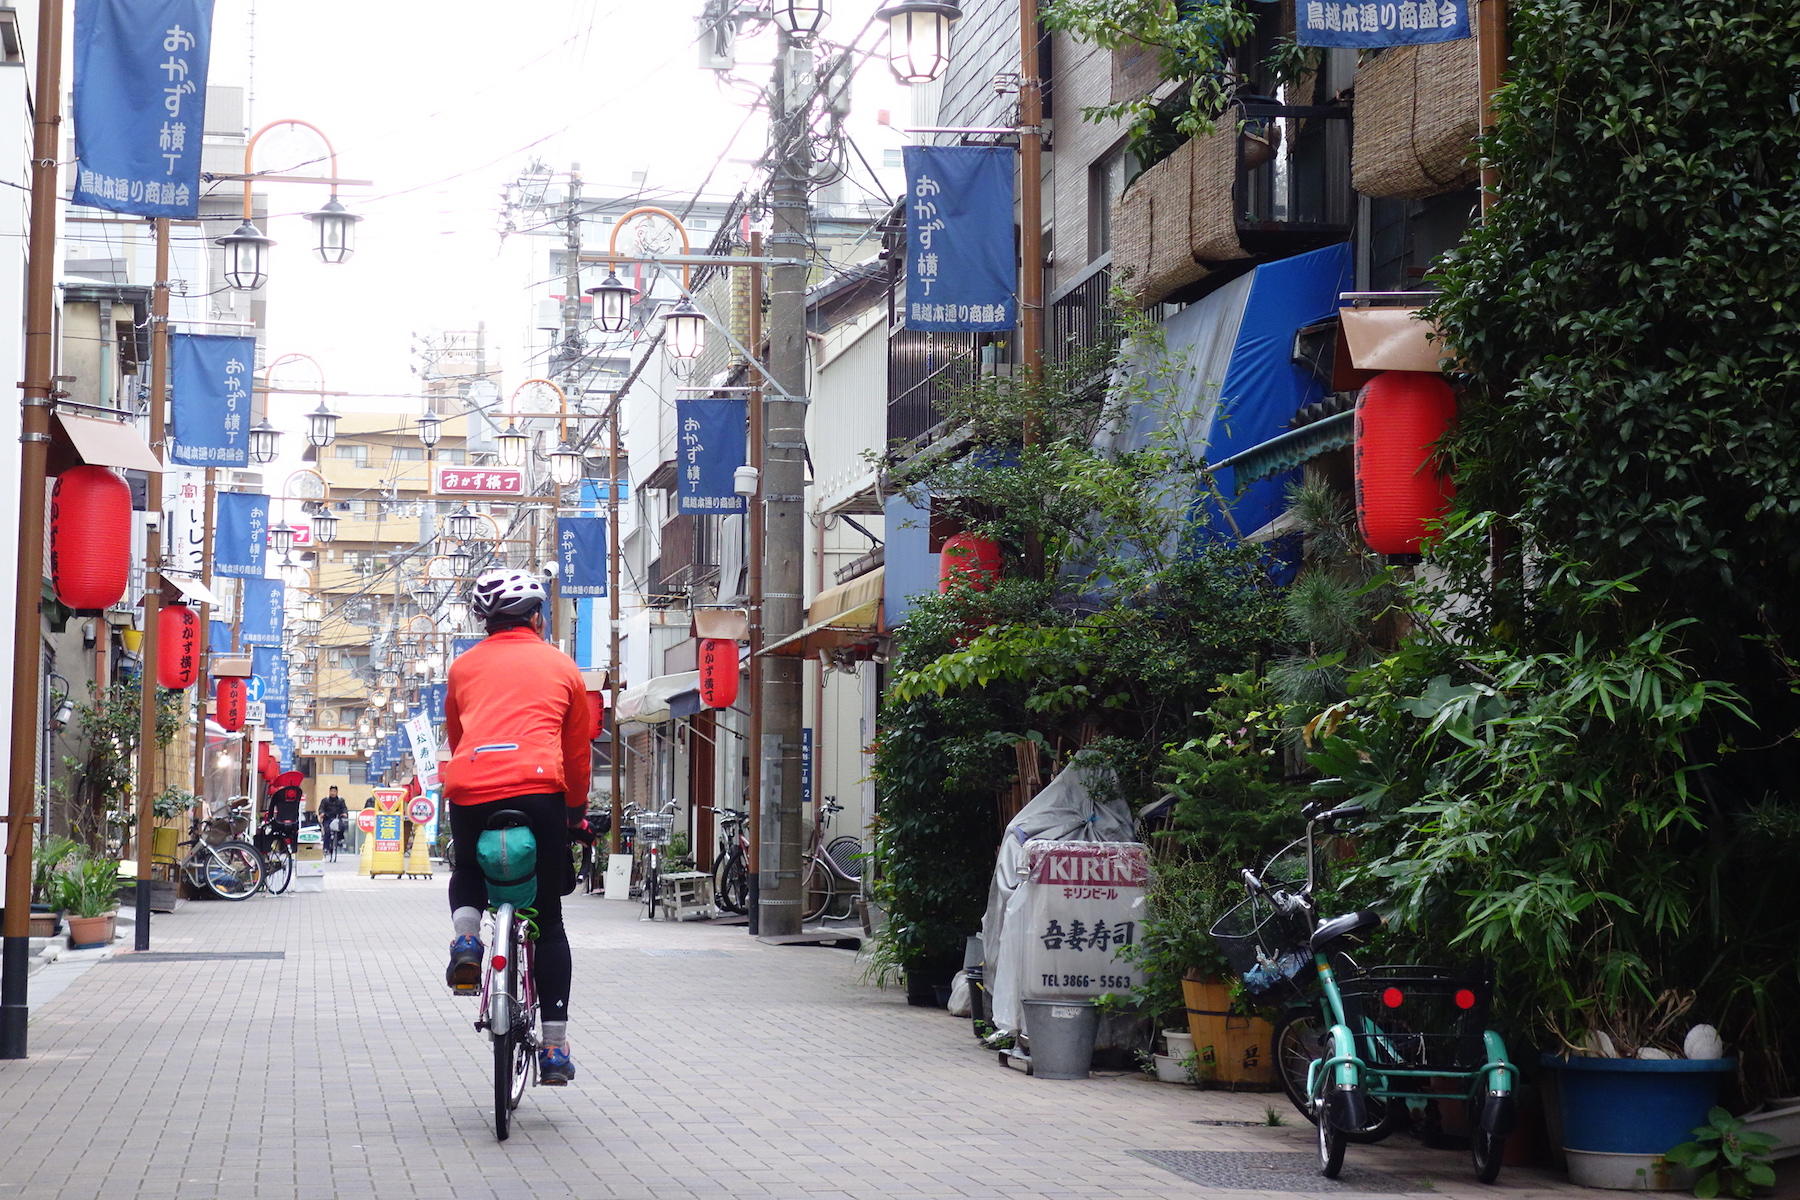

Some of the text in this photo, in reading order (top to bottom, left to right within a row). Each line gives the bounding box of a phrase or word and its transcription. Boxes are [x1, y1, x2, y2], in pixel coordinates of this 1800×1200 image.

[1307, 1, 1457, 32] 鳥越本通り商盛会
[160, 24, 196, 176] おかず横丁
[80, 170, 190, 207] 鳥越本通り商盛会
[914, 175, 944, 296] おかず横丁
[911, 303, 1005, 323] 鳥越本通り商盛会
[224, 358, 246, 444] おかず横丁
[682, 417, 704, 492] おかず横丁
[443, 472, 518, 490] おかず横丁
[250, 507, 264, 563] おかず横丁
[561, 529, 577, 583] おかず横丁
[179, 613, 194, 683] おかず横丁
[704, 641, 716, 702] おかず横丁
[1048, 856, 1133, 881] KIRIN
[1063, 887, 1119, 900] キリンビール
[1040, 919, 1135, 952] 吾妻寿司
[1041, 974, 1059, 987] TEL
